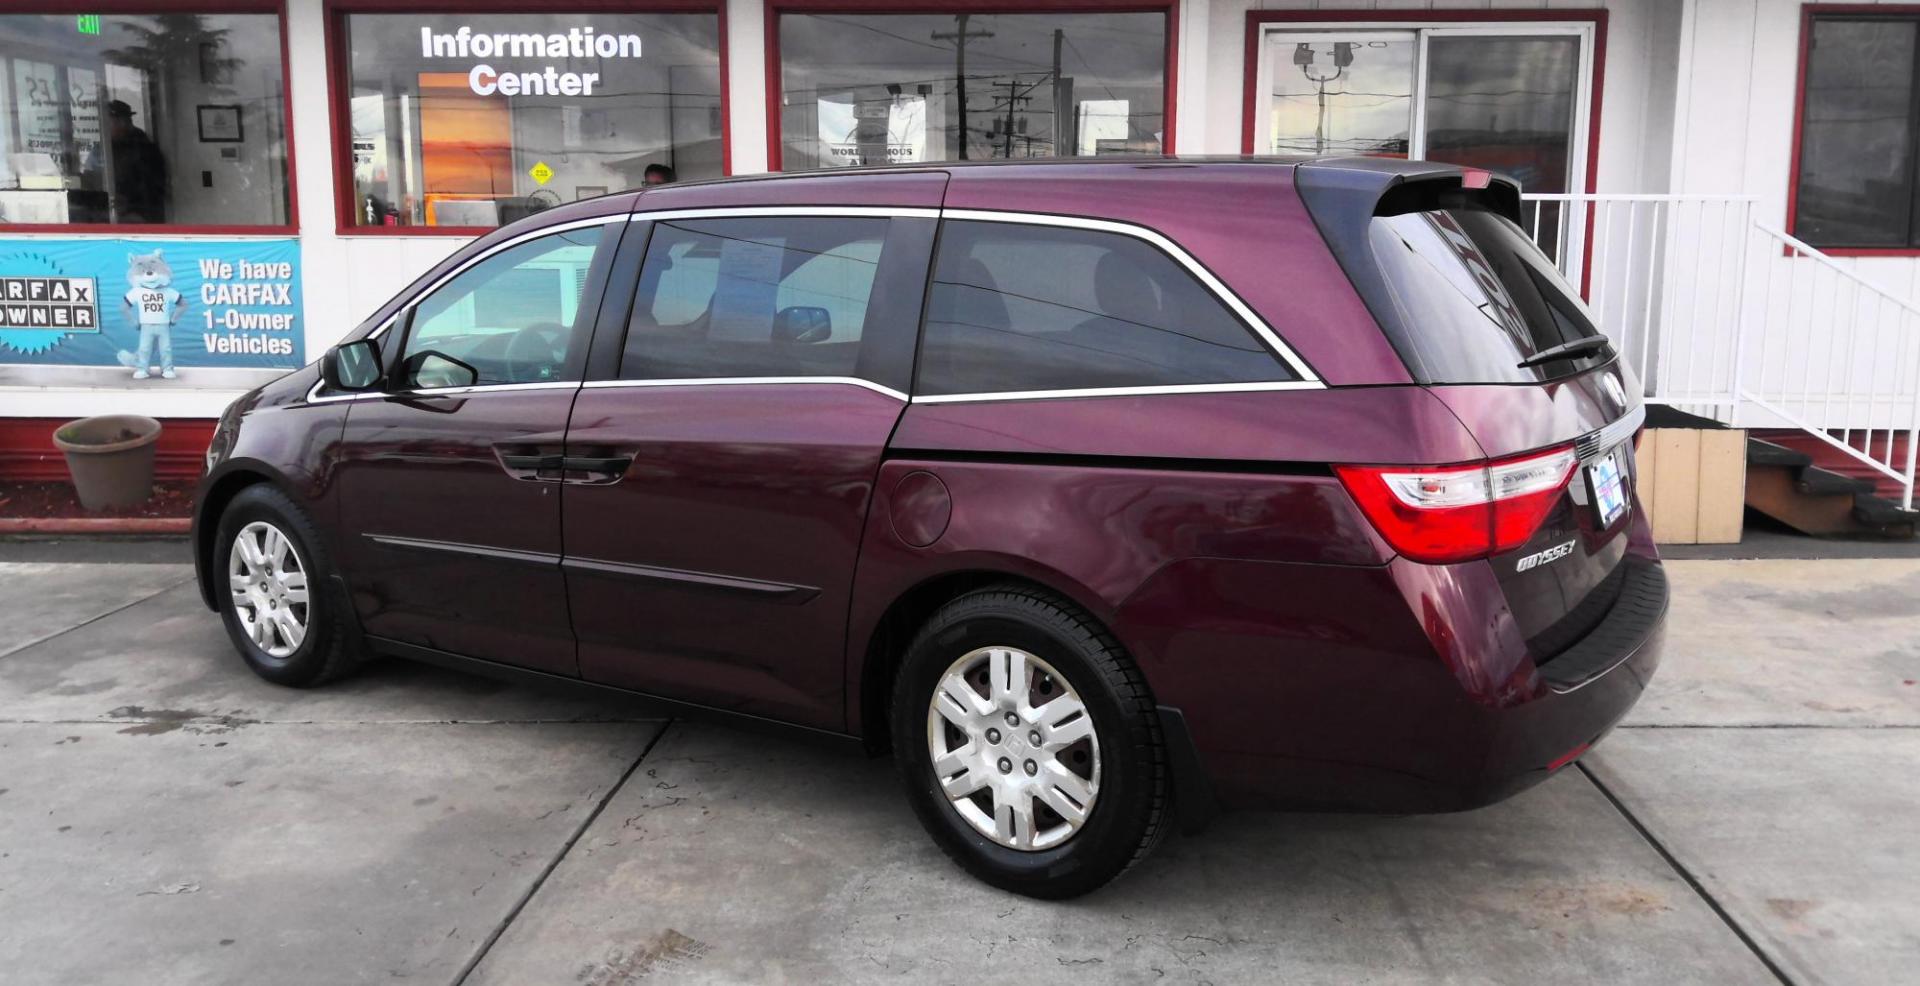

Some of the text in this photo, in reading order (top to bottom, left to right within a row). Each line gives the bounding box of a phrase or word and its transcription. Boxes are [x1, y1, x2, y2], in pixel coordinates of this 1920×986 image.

[420, 27, 642, 59] Information
[469, 64, 599, 97] Center
[200, 259, 292, 280] We have
[0, 281, 89, 302] RFAX
[142, 293, 165, 303] CAR
[201, 283, 292, 305] CARFAX
[0, 308, 91, 325] WNER
[144, 303, 165, 314] FOX
[203, 310, 293, 330] 1-Owner
[203, 333, 293, 354] Vehicles
[1516, 540, 1576, 573] ODYSSEY
